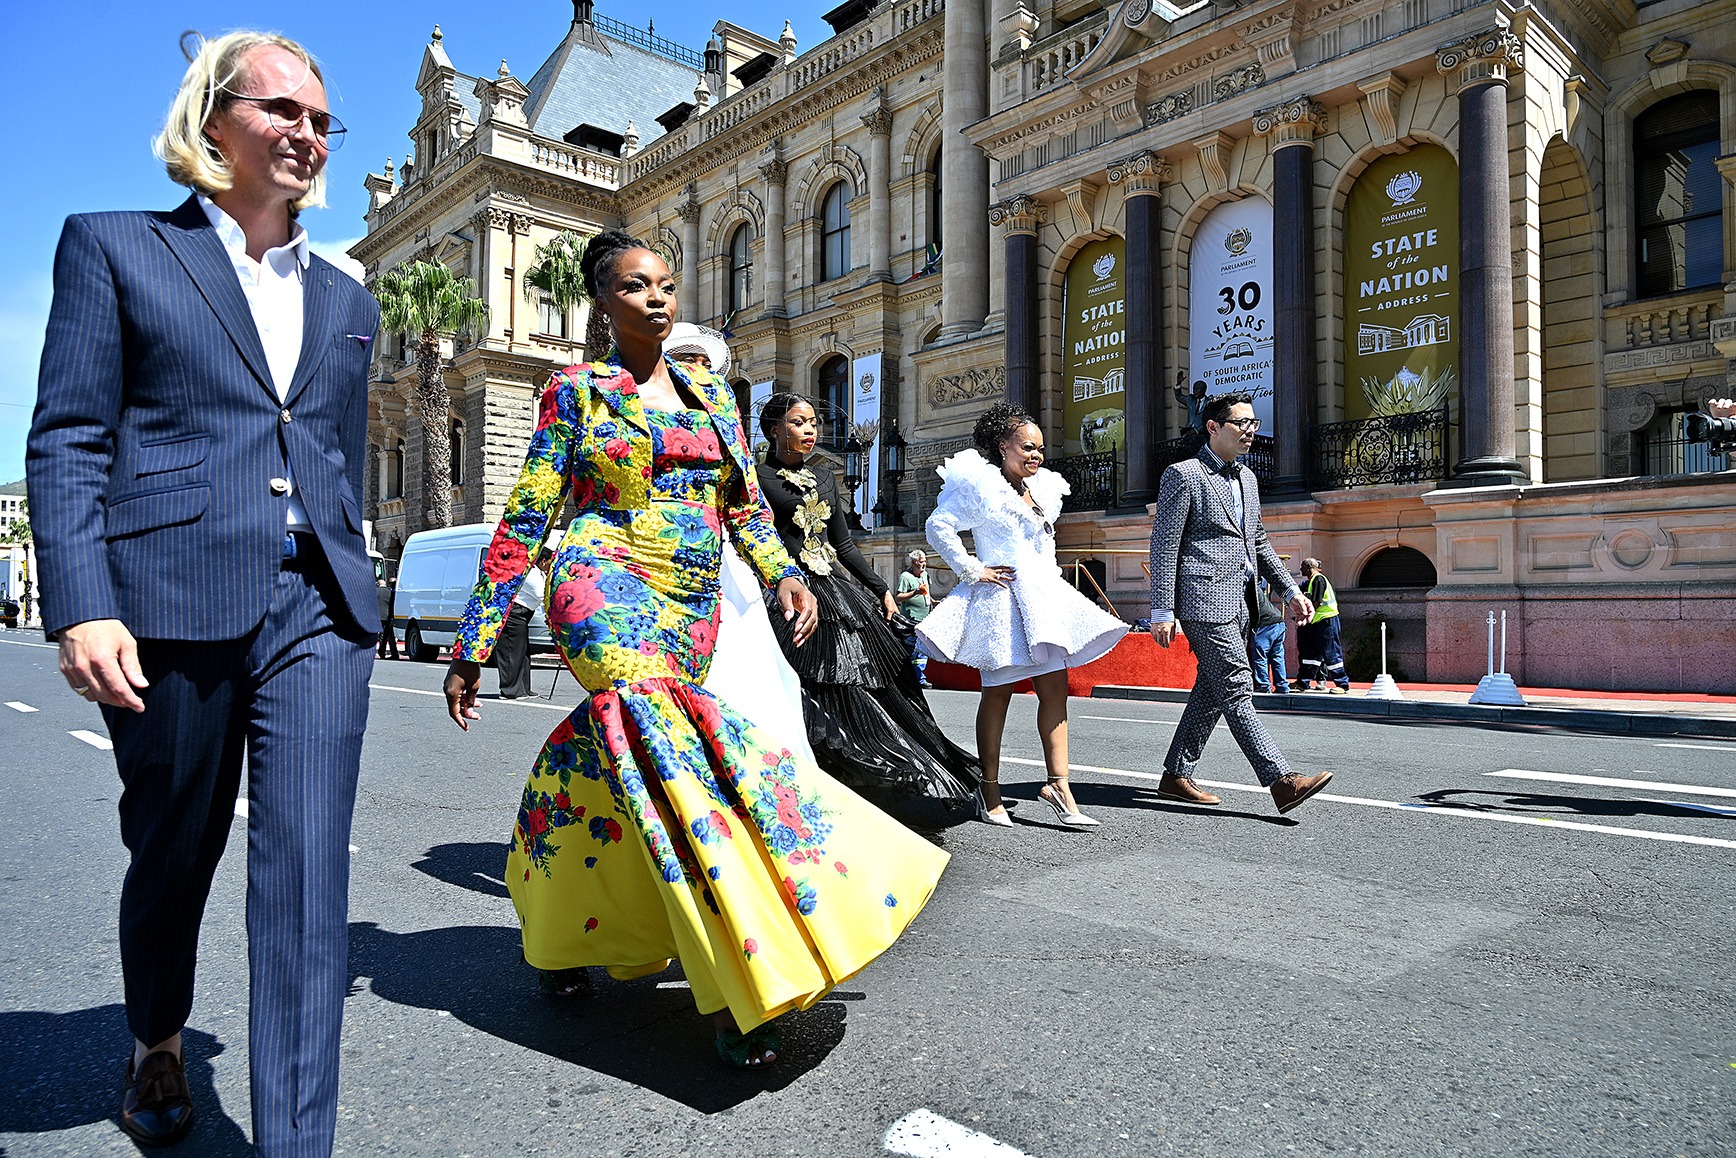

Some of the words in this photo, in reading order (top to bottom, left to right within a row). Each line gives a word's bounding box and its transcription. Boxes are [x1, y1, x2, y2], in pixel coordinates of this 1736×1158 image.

[1381, 206, 1427, 223] PARLIAMENT
[1371, 228, 1438, 259] STATE
[1220, 258, 1257, 273] PARLIAMENT
[1386, 256, 1401, 270] of
[1401, 254, 1420, 265] the
[1087, 281, 1118, 294] PARLIAMENT
[1360, 264, 1448, 298] NATION
[1216, 281, 1261, 316] 30
[1377, 294, 1429, 311] ADDRESS
[1081, 299, 1124, 324] STATE
[1091, 320, 1101, 333] of
[1100, 319, 1113, 328] the
[1212, 314, 1266, 339] YEARS
[1085, 351, 1119, 366] ADDRESS
[1203, 369, 1213, 379] OF
[1214, 365, 1239, 377] SOUTH
[1215, 371, 1263, 386] DEMOCRATIC
